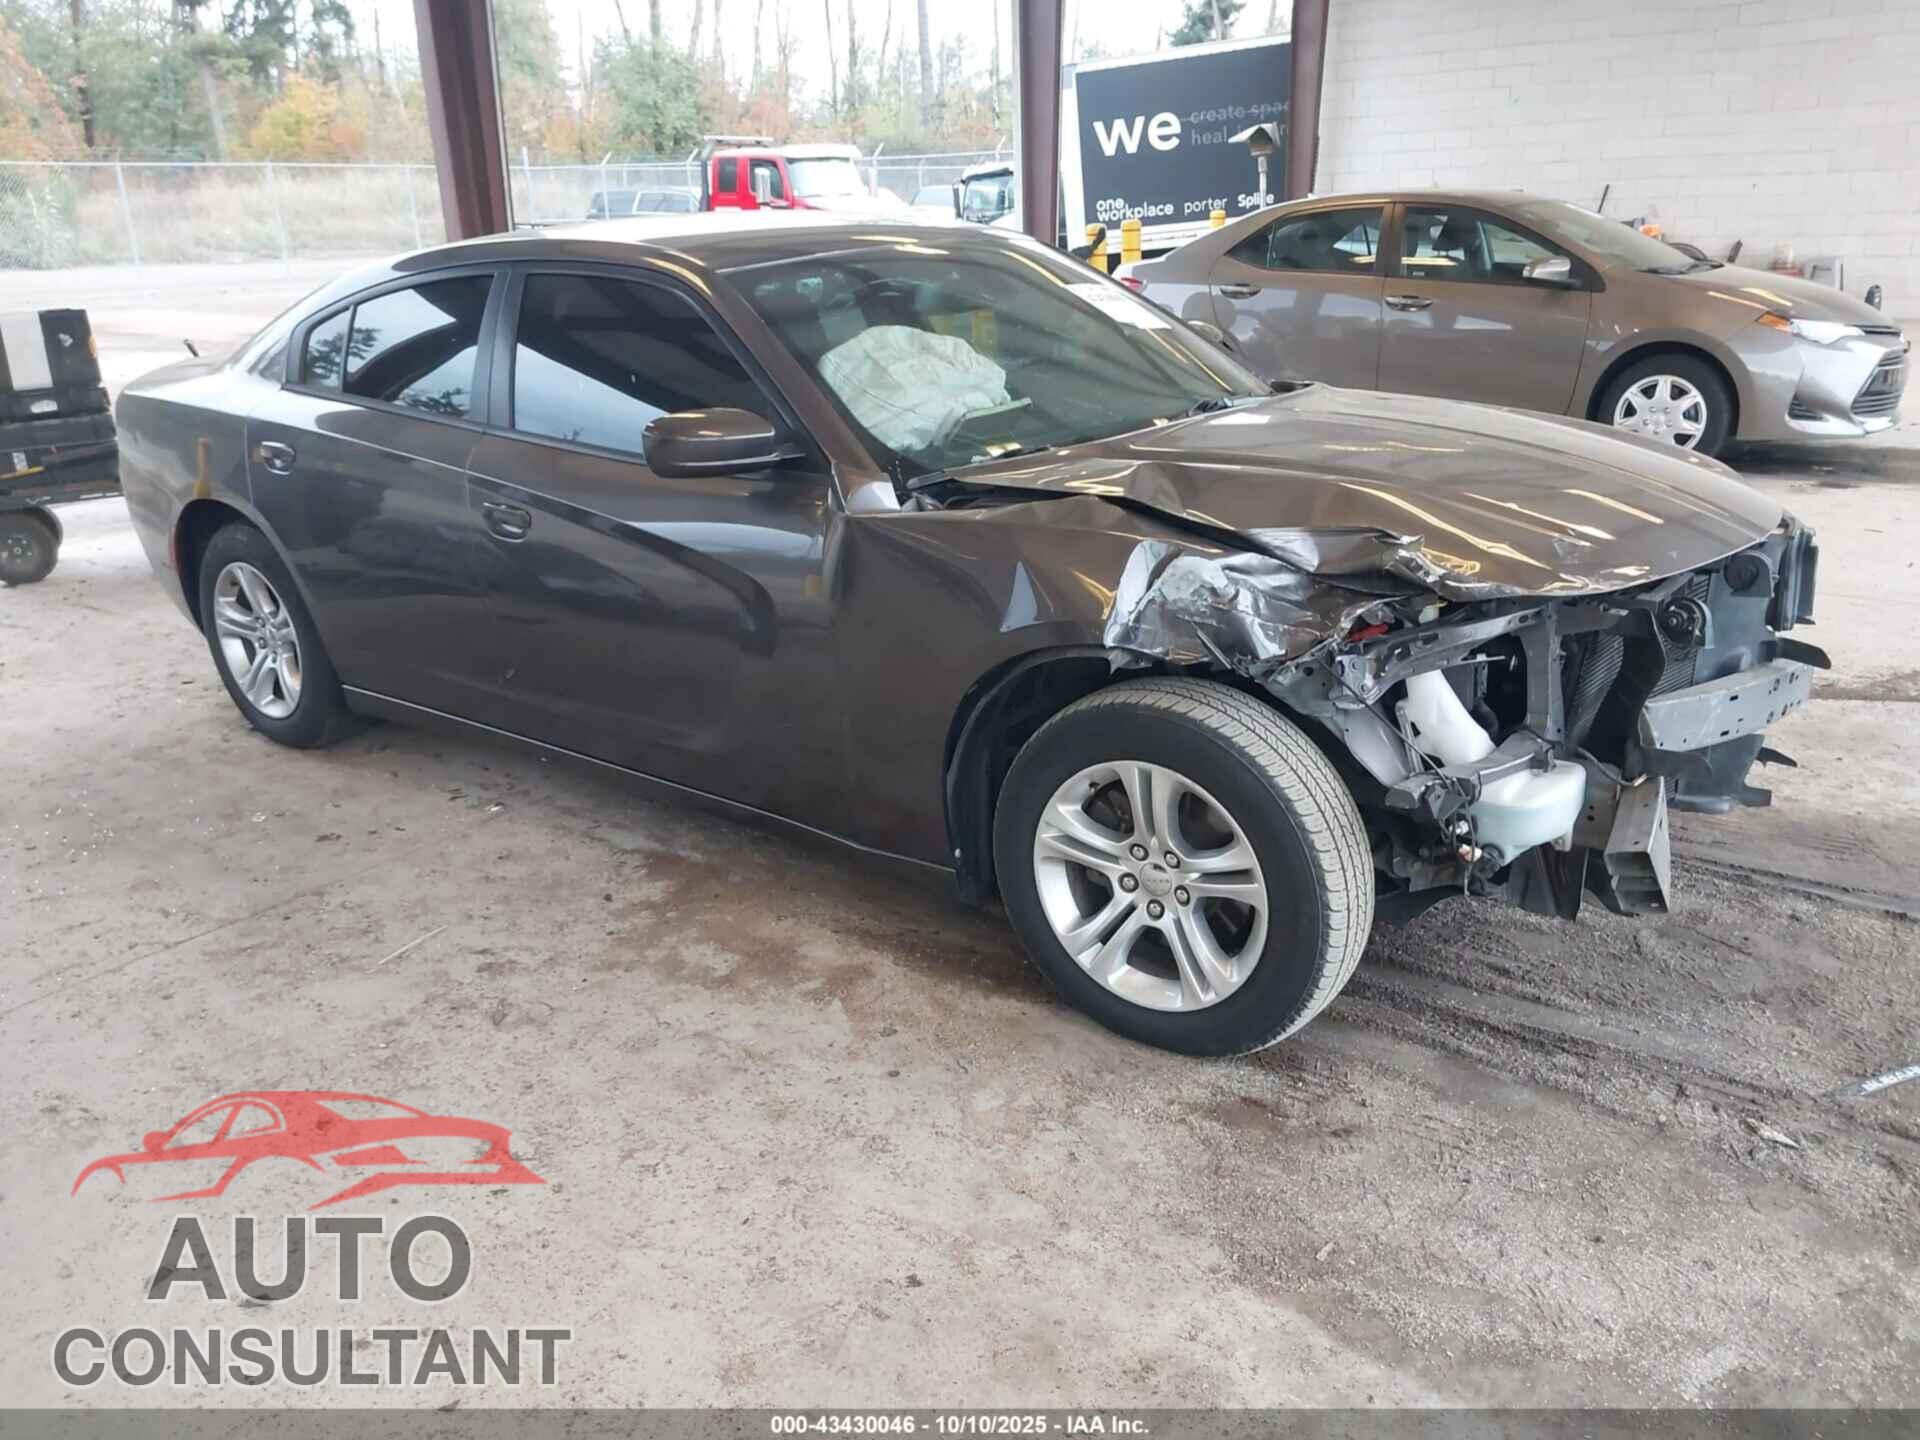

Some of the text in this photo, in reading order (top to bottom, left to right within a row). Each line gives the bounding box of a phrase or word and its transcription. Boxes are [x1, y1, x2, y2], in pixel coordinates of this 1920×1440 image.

[1093, 111, 1182, 156] we
[1096, 198, 1125, 213] one
[1184, 197, 1228, 216] porter
[1237, 192, 1275, 209] Splie
[1097, 202, 1175, 222] workplace
